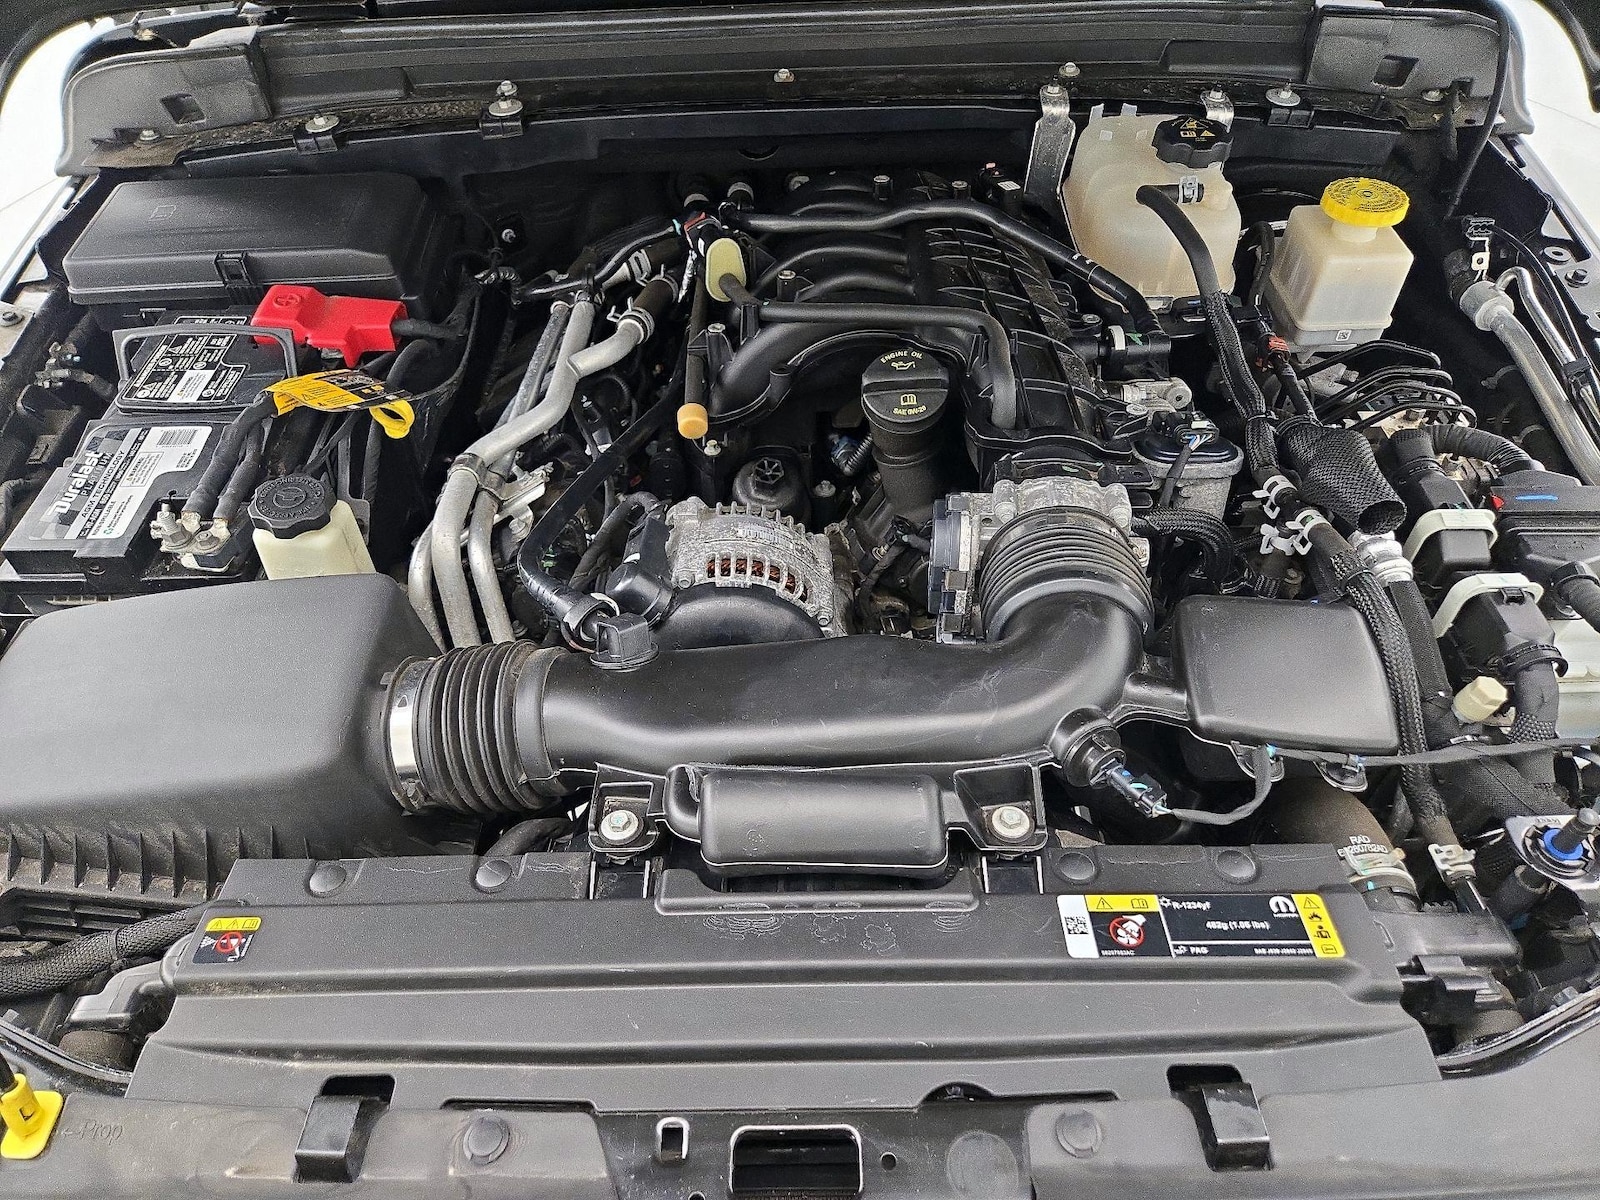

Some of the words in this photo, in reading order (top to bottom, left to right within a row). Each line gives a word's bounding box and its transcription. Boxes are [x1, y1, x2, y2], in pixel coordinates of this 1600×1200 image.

[881, 351, 908, 363] ENGINE
[911, 351, 923, 360] OIL
[893, 407, 907, 416] SAE
[907, 405, 927, 415] 0W-20
[80, 452, 113, 495] PLATINUM
[46, 451, 104, 515] Duralast
[81, 500, 95, 517] AGM
[92, 450, 122, 497] TECHNOLOGY
[1349, 835, 1370, 844] RAD
[1337, 844, 1388, 857] 6280782AD
[1172, 901, 1211, 911] R-1234yf
[1251, 921, 1270, 930] lbs)
